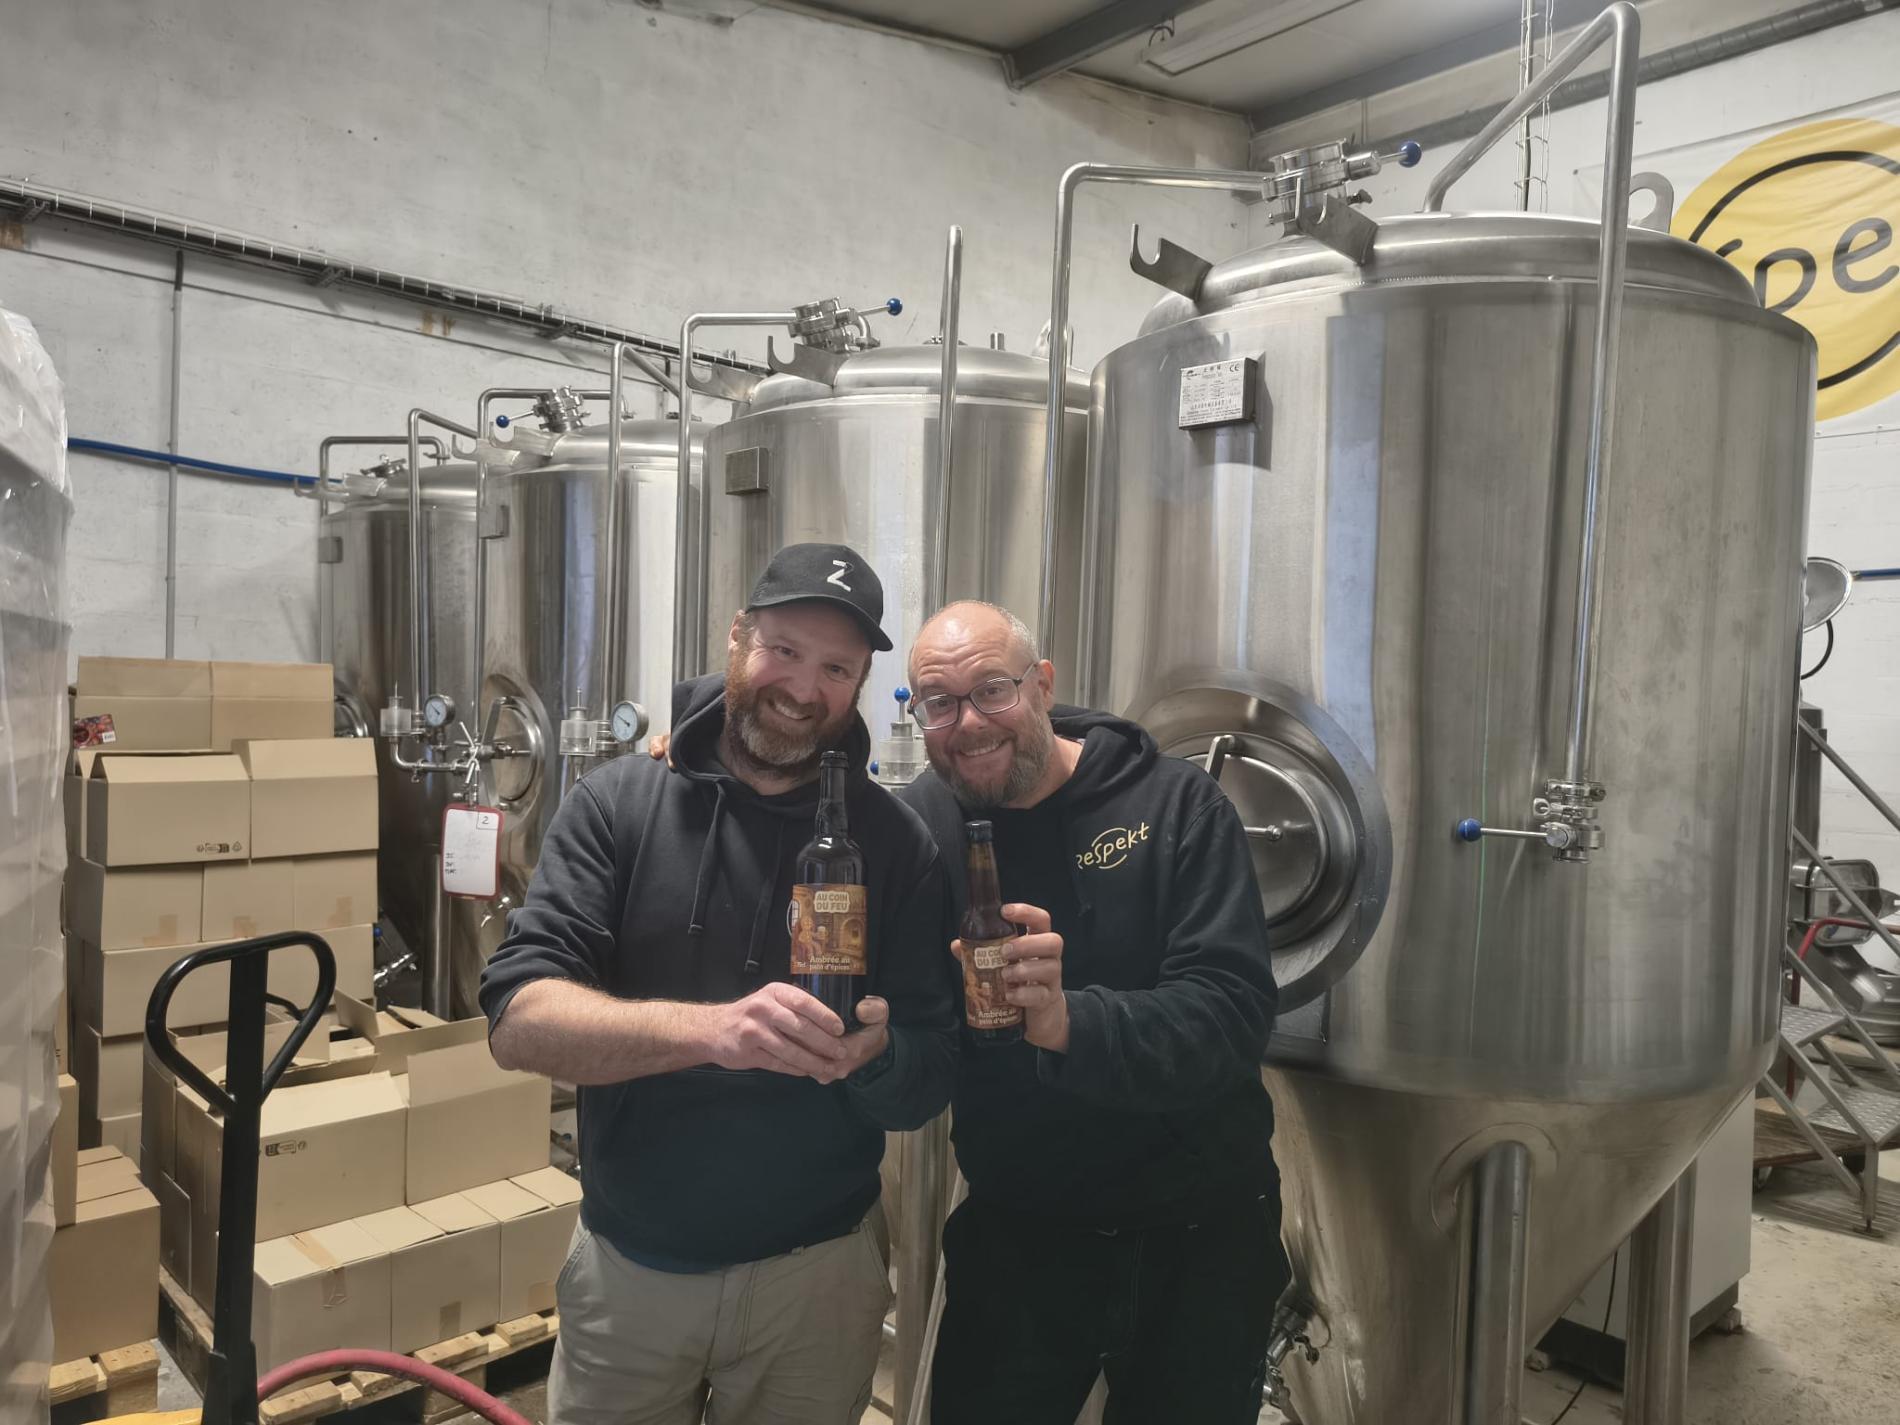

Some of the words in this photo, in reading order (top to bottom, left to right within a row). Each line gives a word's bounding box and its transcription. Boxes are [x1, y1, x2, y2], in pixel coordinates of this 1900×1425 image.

[1715, 217, 1900, 316] pe
[827, 560, 852, 592] Z
[482, 816, 489, 825] 2
[829, 892, 848, 901] COIN
[830, 902, 847, 910] FEU
